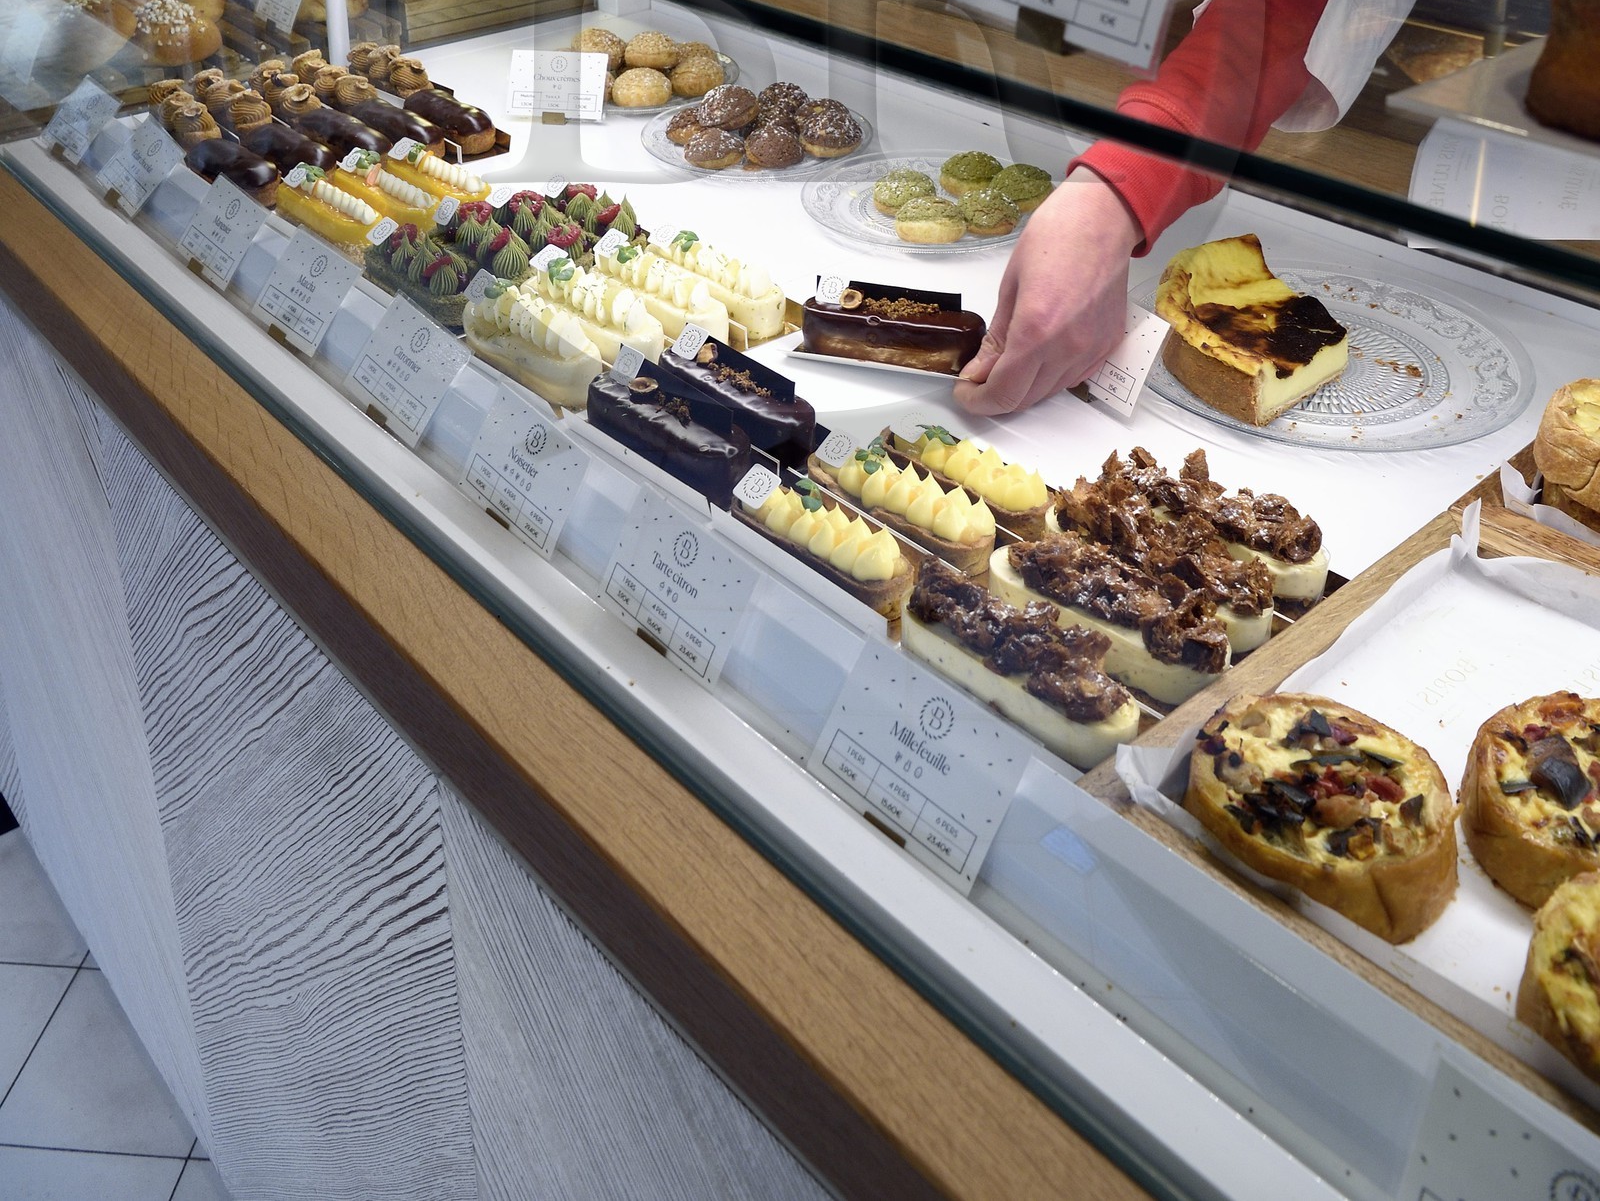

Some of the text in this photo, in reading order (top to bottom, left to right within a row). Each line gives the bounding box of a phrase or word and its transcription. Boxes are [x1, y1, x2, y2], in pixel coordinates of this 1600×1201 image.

[509, 446, 540, 479] Noisetier
[653, 551, 699, 599] Tarte citron
[851, 749, 867, 766] PERS
[890, 720, 951, 776] Millefeuille
[894, 784, 912, 803] PERS
[941, 819, 959, 839] PERS
